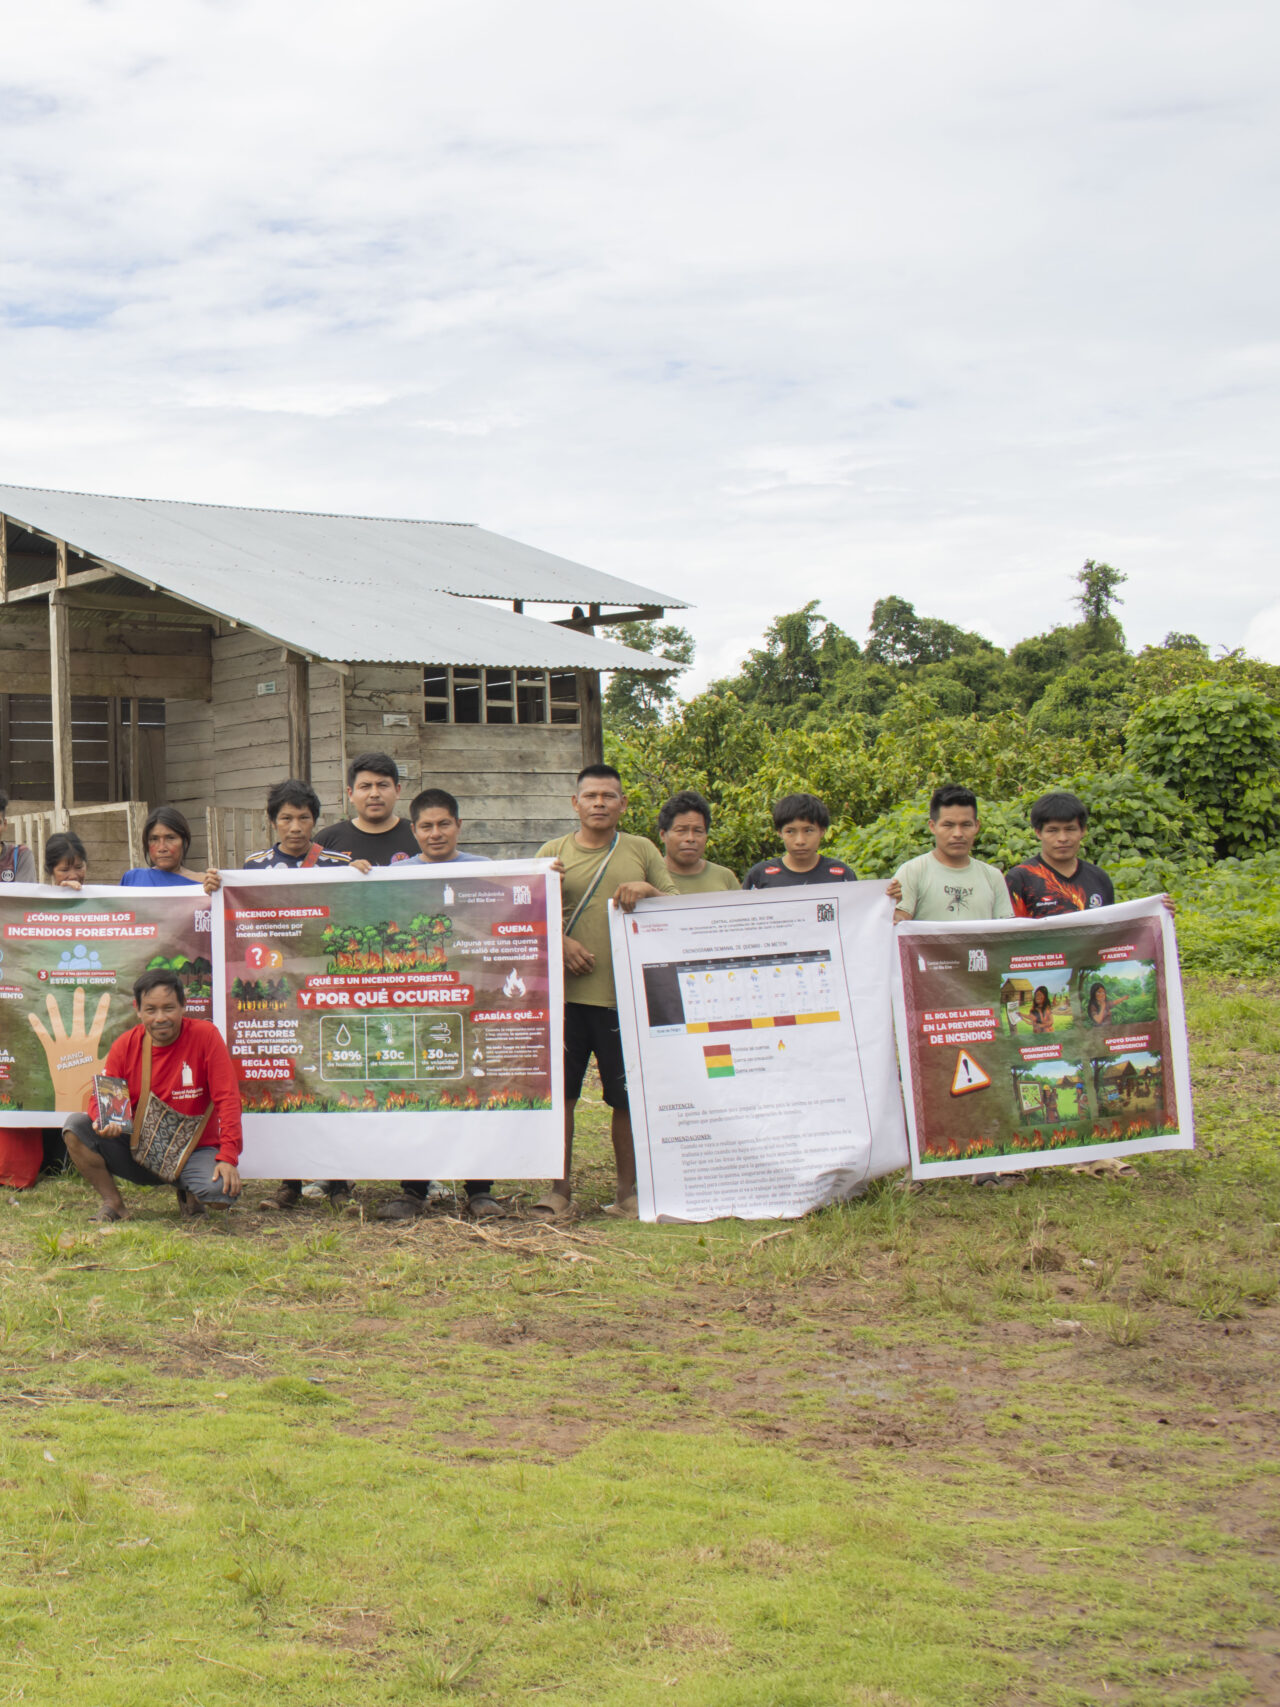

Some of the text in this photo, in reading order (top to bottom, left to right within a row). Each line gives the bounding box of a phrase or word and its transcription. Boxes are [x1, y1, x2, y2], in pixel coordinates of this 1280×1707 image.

[27, 912, 131, 923] ¿CÓMO PREVENIR LOS
[235, 908, 324, 918] INCENDIO FORESTAL
[8, 926, 156, 938] INCENDIOS FORESTALES?
[235, 923, 254, 931] ¿Qué
[497, 924, 534, 934] QUEMA
[1011, 955, 1047, 963] PREVENCIÓN
[1045, 960, 1065, 968] HOGAR
[40, 971, 47, 979] 3
[50, 977, 117, 985] ESTAR EN GRUPO
[307, 974, 455, 987] ¿QUÉ ES UN INCENDIO FORESTAL
[300, 988, 470, 1007] Y POR QUÉ OCURRE?
[474, 1011, 512, 1022] ¿SABÍAS
[949, 1011, 959, 1019] DE
[959, 1010, 968, 1018] LA
[969, 1009, 991, 1018] MUJER
[233, 1018, 299, 1030] ¿CUÁLES SON
[923, 1018, 996, 1032] EN LA PREVENCIÓN
[236, 1029, 296, 1038] 3 FACTORES
[930, 1030, 993, 1044] DE INCENDIOS
[232, 1044, 304, 1055] DEL FUEGO?
[427, 1049, 444, 1059] 30
[60, 1051, 84, 1063] MANO
[332, 1050, 362, 1061] 30%
[56, 1055, 94, 1071] PAAMARI
[241, 1059, 290, 1067] REGLA DEL
[245, 1069, 290, 1079] 30/30/30
